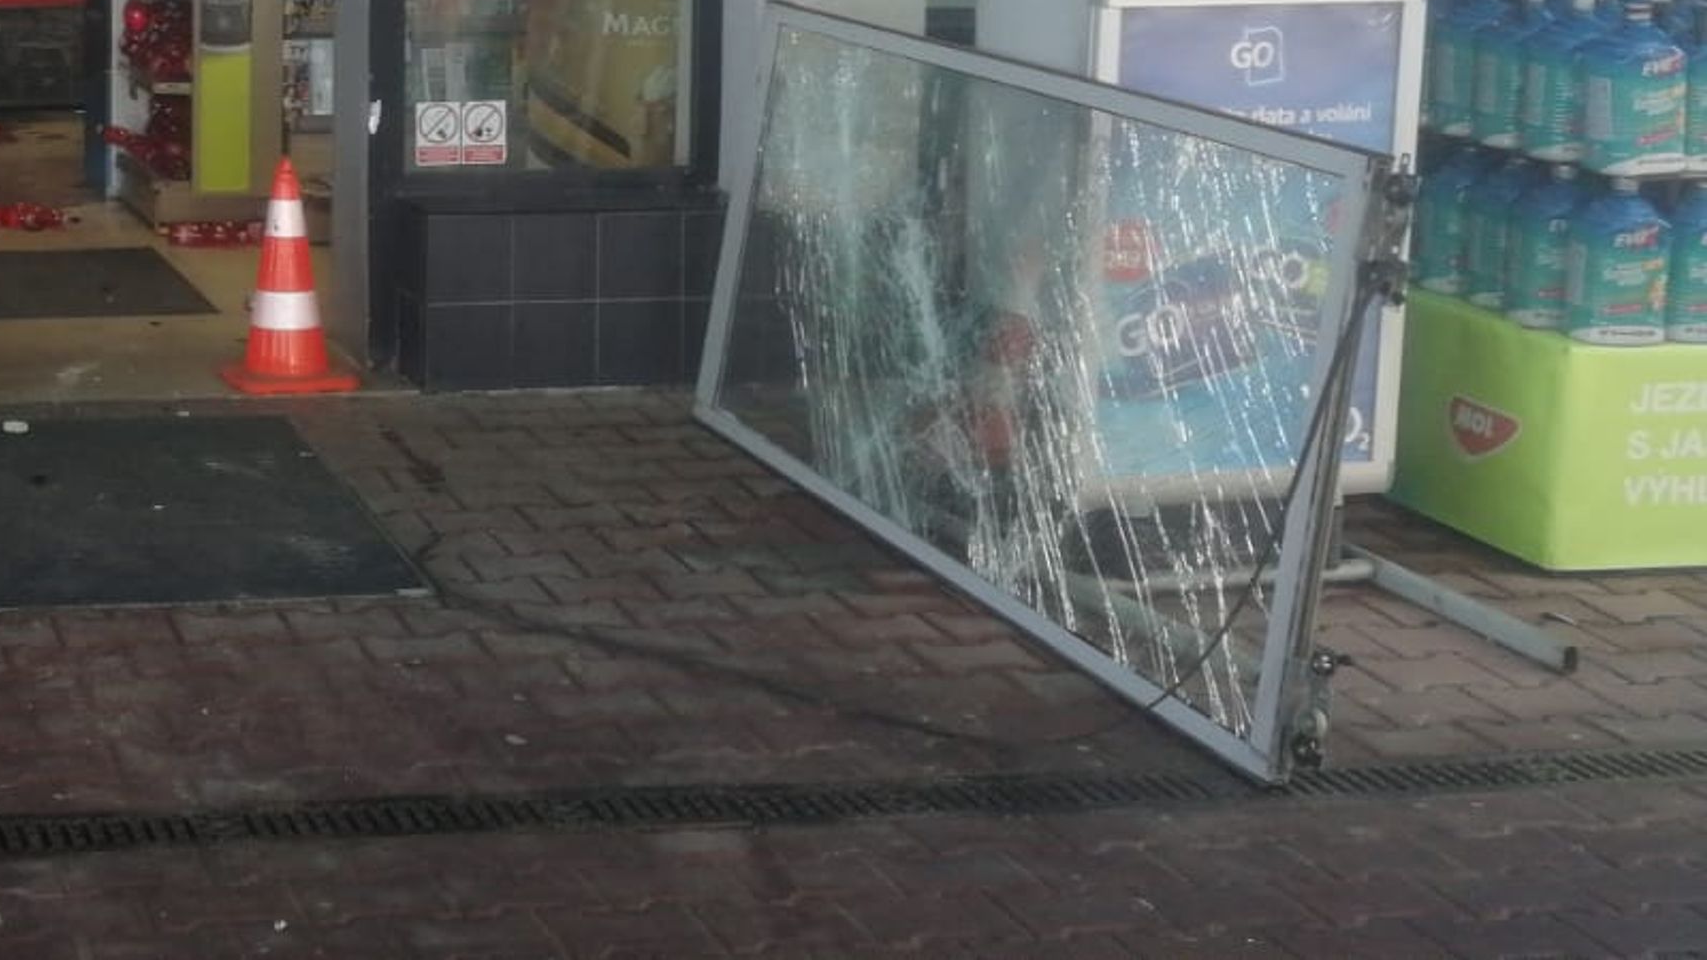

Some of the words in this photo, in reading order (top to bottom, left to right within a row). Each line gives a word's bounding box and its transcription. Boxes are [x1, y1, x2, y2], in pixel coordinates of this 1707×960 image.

[601, 12, 671, 36] MAG
[1230, 40, 1276, 69] GO
[1251, 105, 1296, 125] data
[1300, 109, 1312, 124] a
[1316, 100, 1372, 123] volání
[1117, 304, 1184, 357] GO
[1630, 382, 1707, 414] JEZ
[1456, 404, 1493, 439] MOL
[1627, 429, 1651, 459] S
